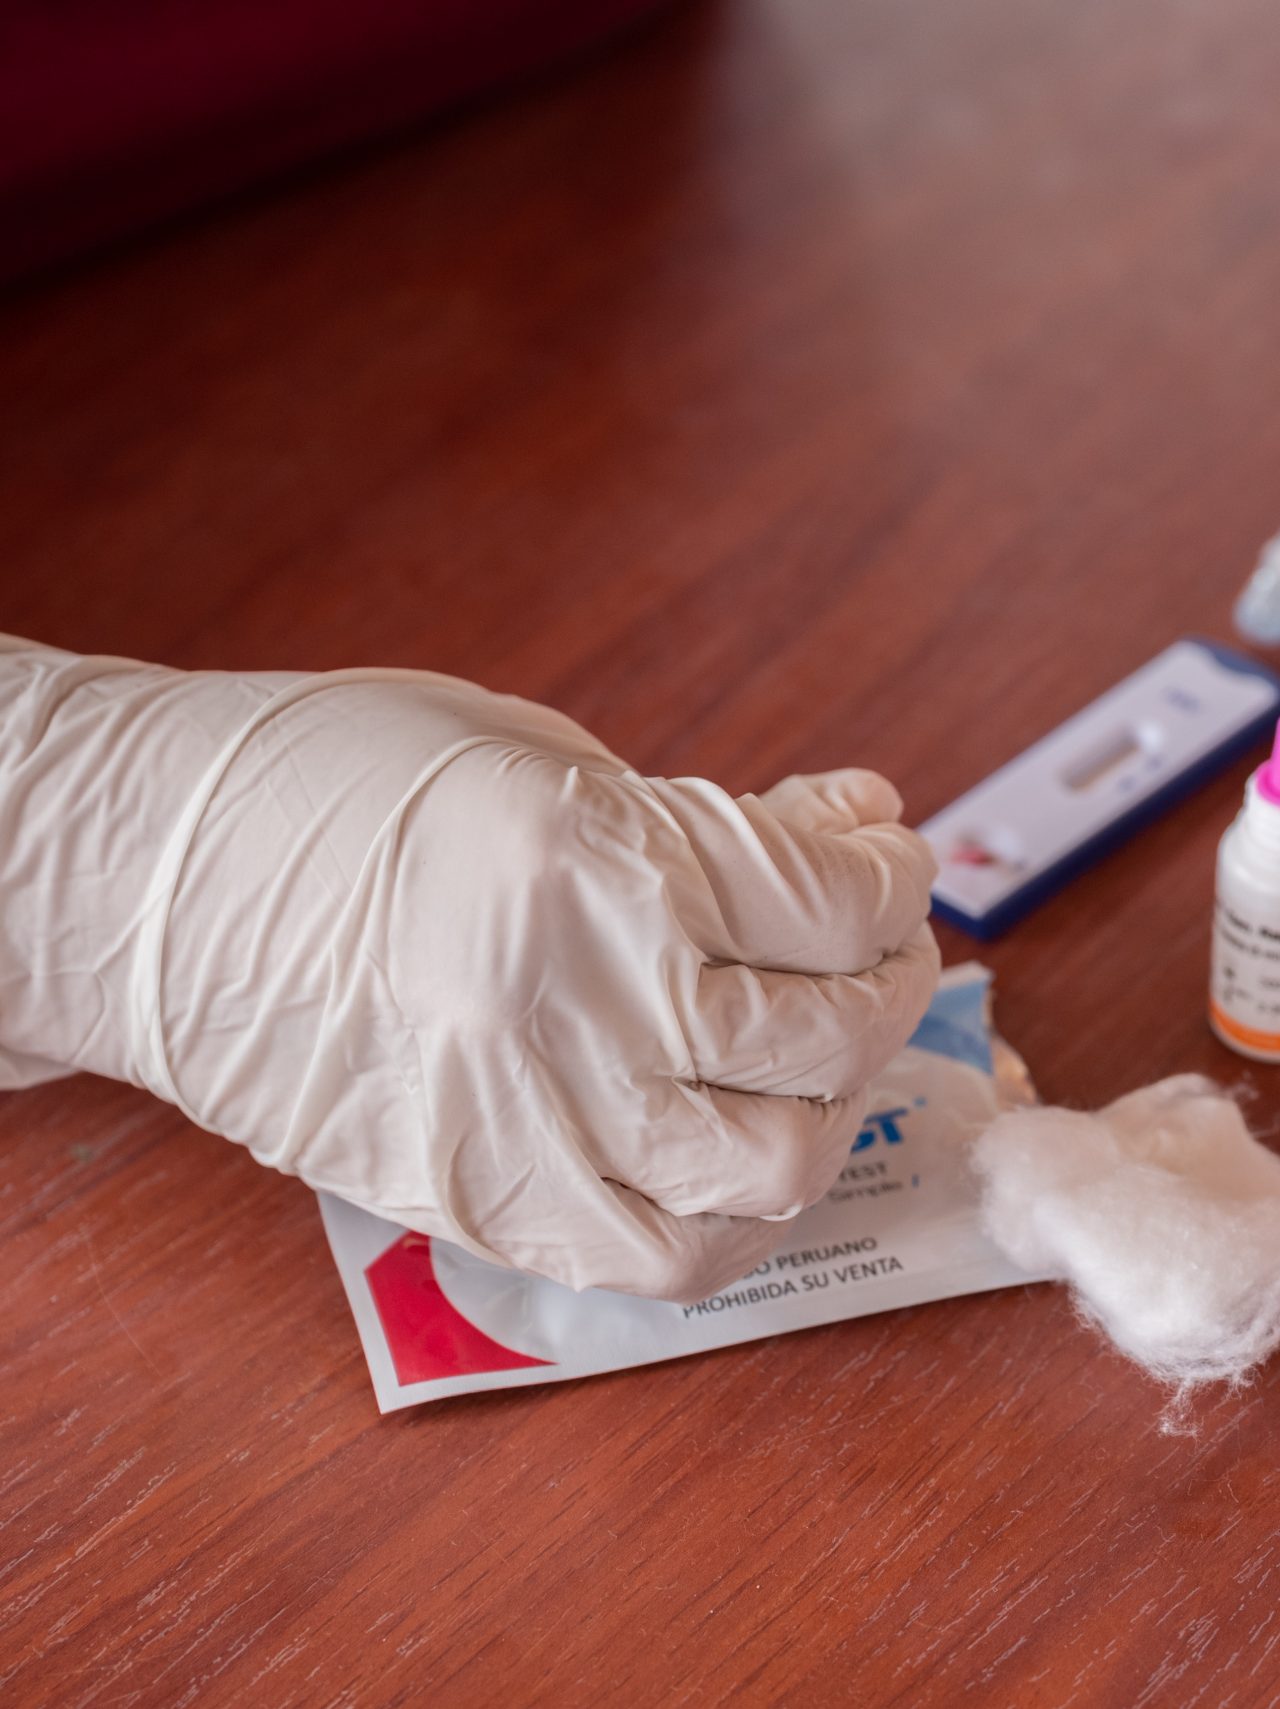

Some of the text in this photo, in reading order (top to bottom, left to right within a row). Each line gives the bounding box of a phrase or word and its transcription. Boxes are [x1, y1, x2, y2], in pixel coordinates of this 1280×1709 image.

[776, 1236, 878, 1271] PERUANO
[682, 1256, 904, 1320] PROHIBIDA SU VENTA
